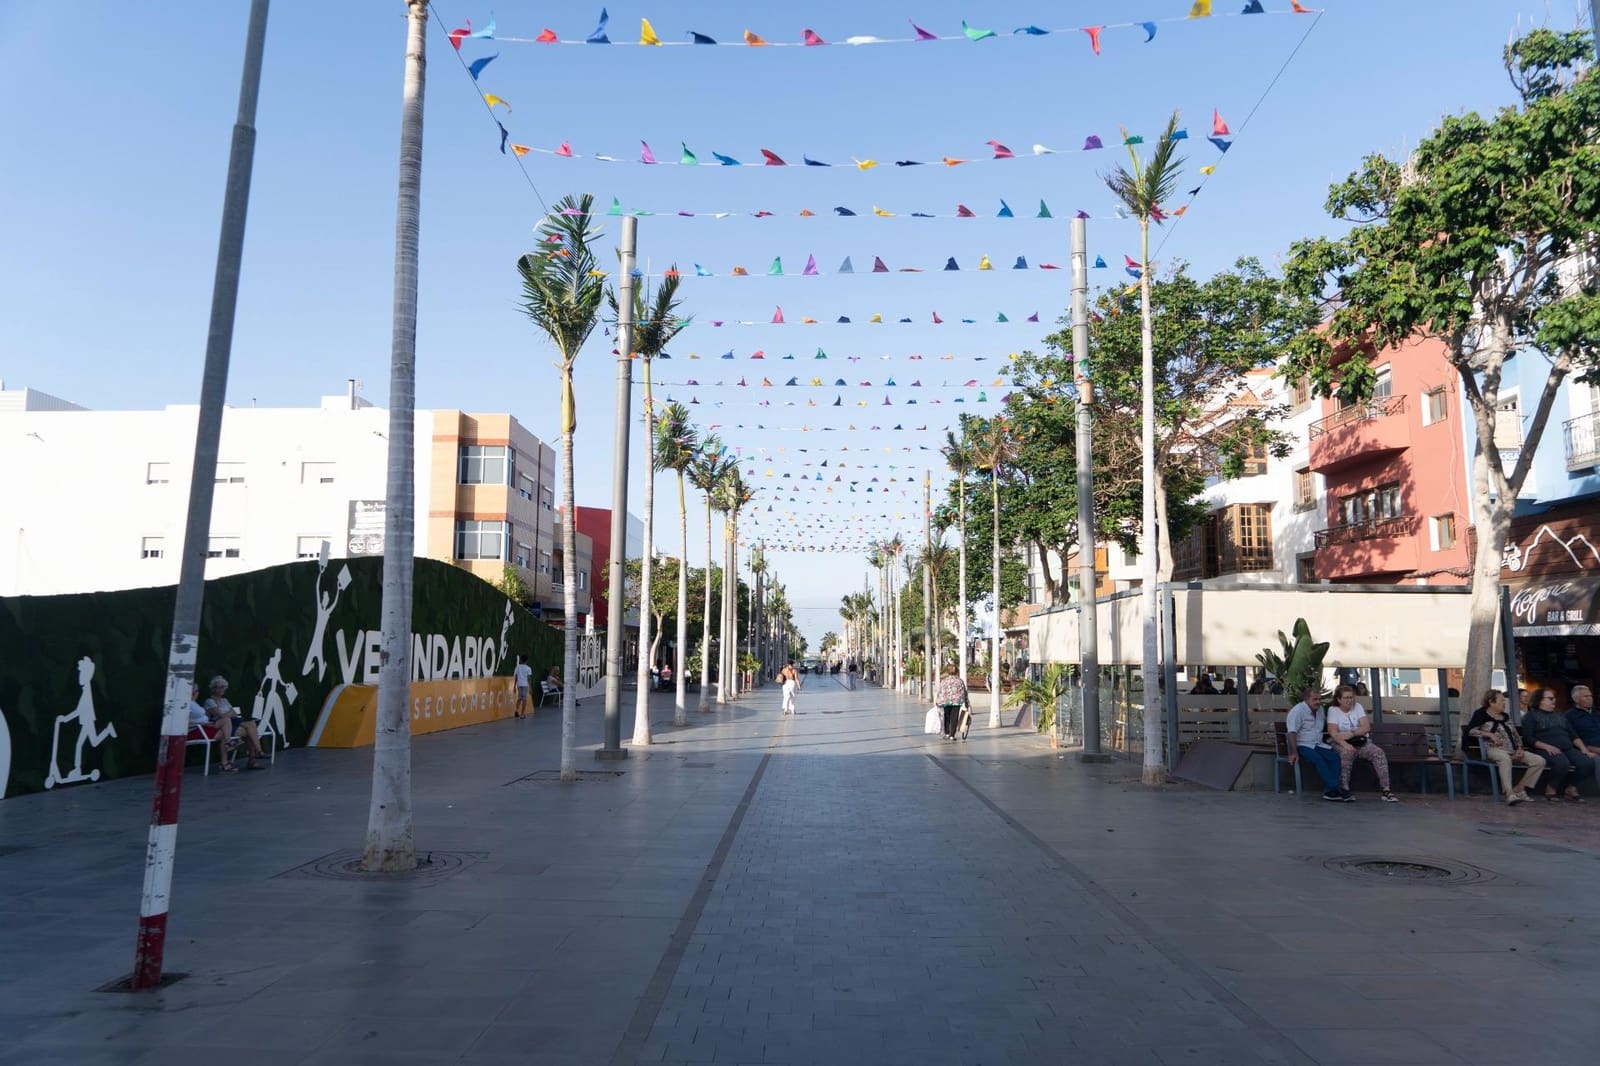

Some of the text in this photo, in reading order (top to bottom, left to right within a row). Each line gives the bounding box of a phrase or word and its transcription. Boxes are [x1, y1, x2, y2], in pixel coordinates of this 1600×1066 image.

[1547, 611, 1559, 622] BAR
[1566, 609, 1584, 621] GRILL
[335, 629, 496, 683] VEINDARIO
[413, 690, 514, 720] SEO COMERCIA
